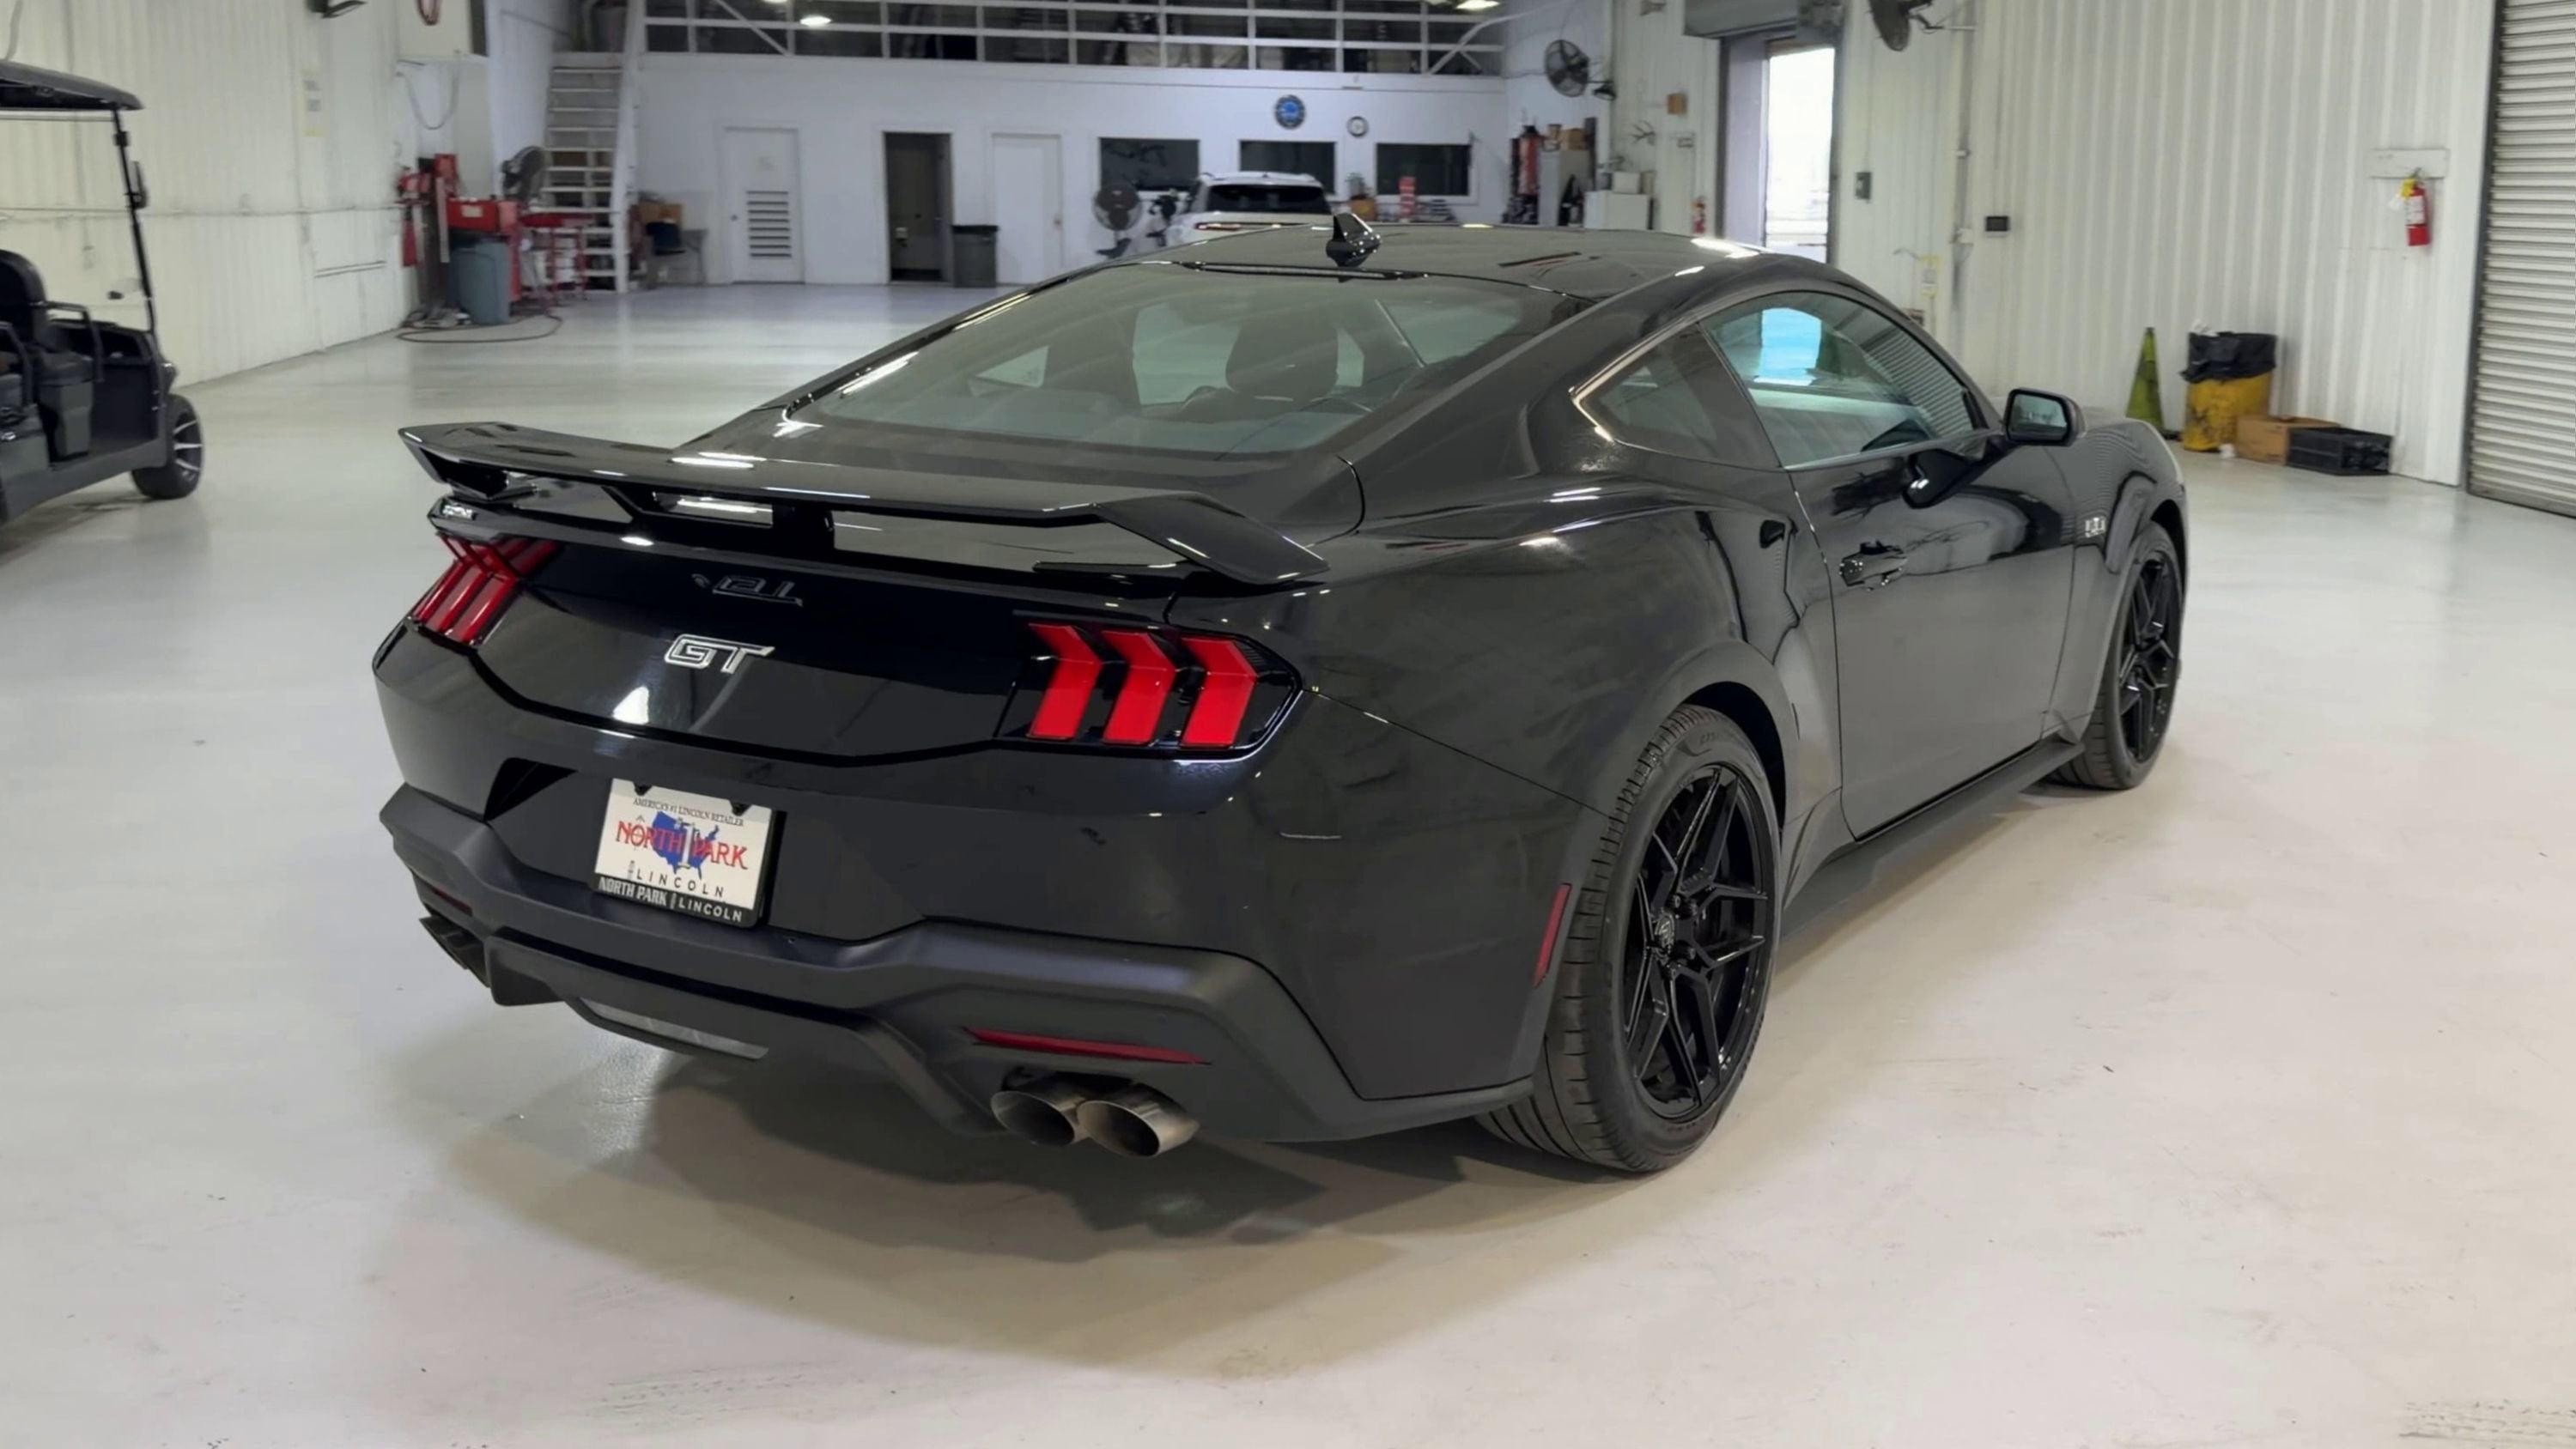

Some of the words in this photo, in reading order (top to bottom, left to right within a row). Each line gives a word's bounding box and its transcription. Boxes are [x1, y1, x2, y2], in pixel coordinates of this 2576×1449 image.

[664, 633, 775, 675] GT
[678, 806, 711, 819] LINCOLN
[711, 814, 744, 827] RETAILER
[615, 821, 683, 853] NORTH
[692, 837, 749, 870] PARK
[598, 876, 635, 898] NORTH
[636, 881, 667, 906] PARK
[678, 895, 743, 923] LINCOLN
[637, 866, 724, 898] LINCOLN
